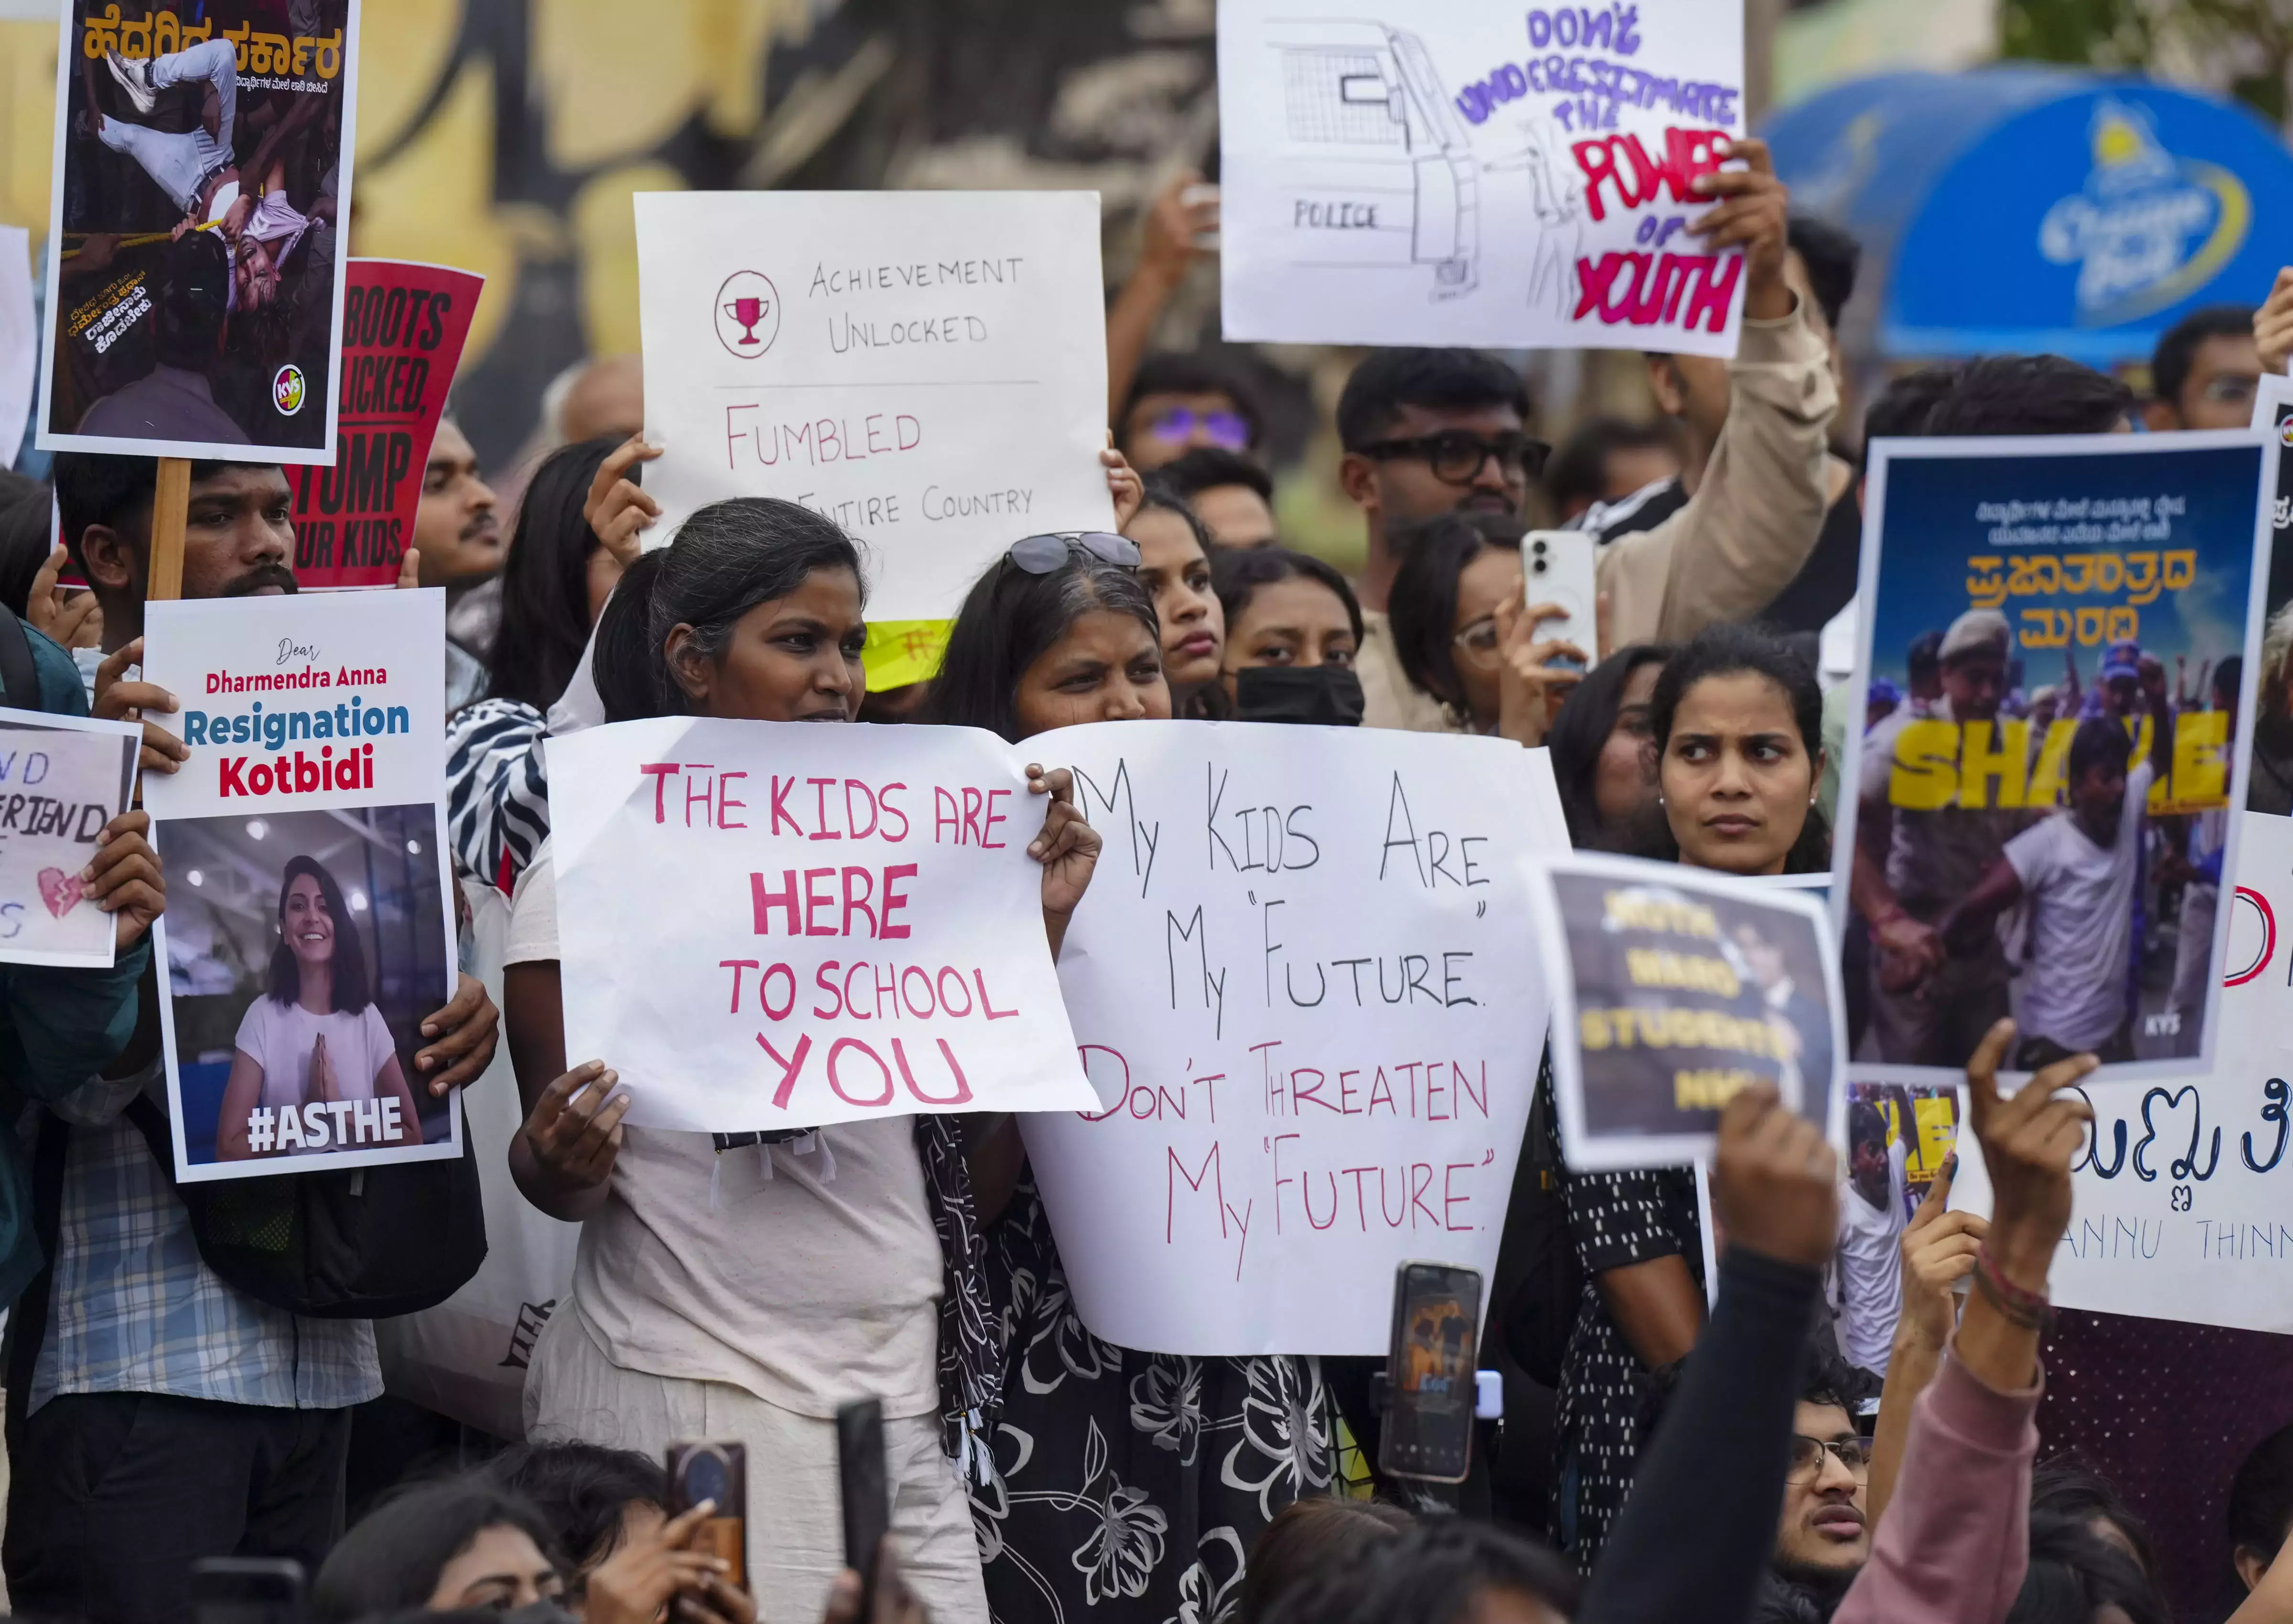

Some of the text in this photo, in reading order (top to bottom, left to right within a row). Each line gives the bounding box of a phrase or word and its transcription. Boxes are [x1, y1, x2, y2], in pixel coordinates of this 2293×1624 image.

[1554, 99, 1620, 133] THE
[1294, 199, 1380, 230] POLICE
[1636, 215, 1686, 248] OF
[809, 258, 1023, 298] ACHIEVEMENT
[1573, 251, 1744, 333] YOUTH
[342, 285, 451, 351] BOOTS
[828, 311, 987, 353] UNLOCKED
[277, 377, 300, 399] KVS
[726, 404, 921, 470] FUMBLED
[297, 432, 412, 515] TOMP
[922, 485, 1033, 521] COUNTRY
[289, 521, 335, 568] UR
[206, 665, 387, 694] Dharmendra Anna
[276, 638, 320, 665] Dear
[184, 695, 409, 751] Resignation
[219, 742, 374, 798] Kotbidi
[1888, 709, 2229, 811] SHAE
[641, 763, 1012, 849] THE KIDS ARE
[1208, 761, 1319, 873] KIDS
[1380, 770, 1490, 887] ARE
[750, 863, 918, 940] HERE
[719, 960, 1019, 1021] TO SCHOOL
[756, 1032, 974, 1110] YOU
[1249, 1041, 1489, 1121] THREATEN
[247, 1095, 403, 1153] #ASTHE
[2060, 1214, 2162, 1259] ANNU
